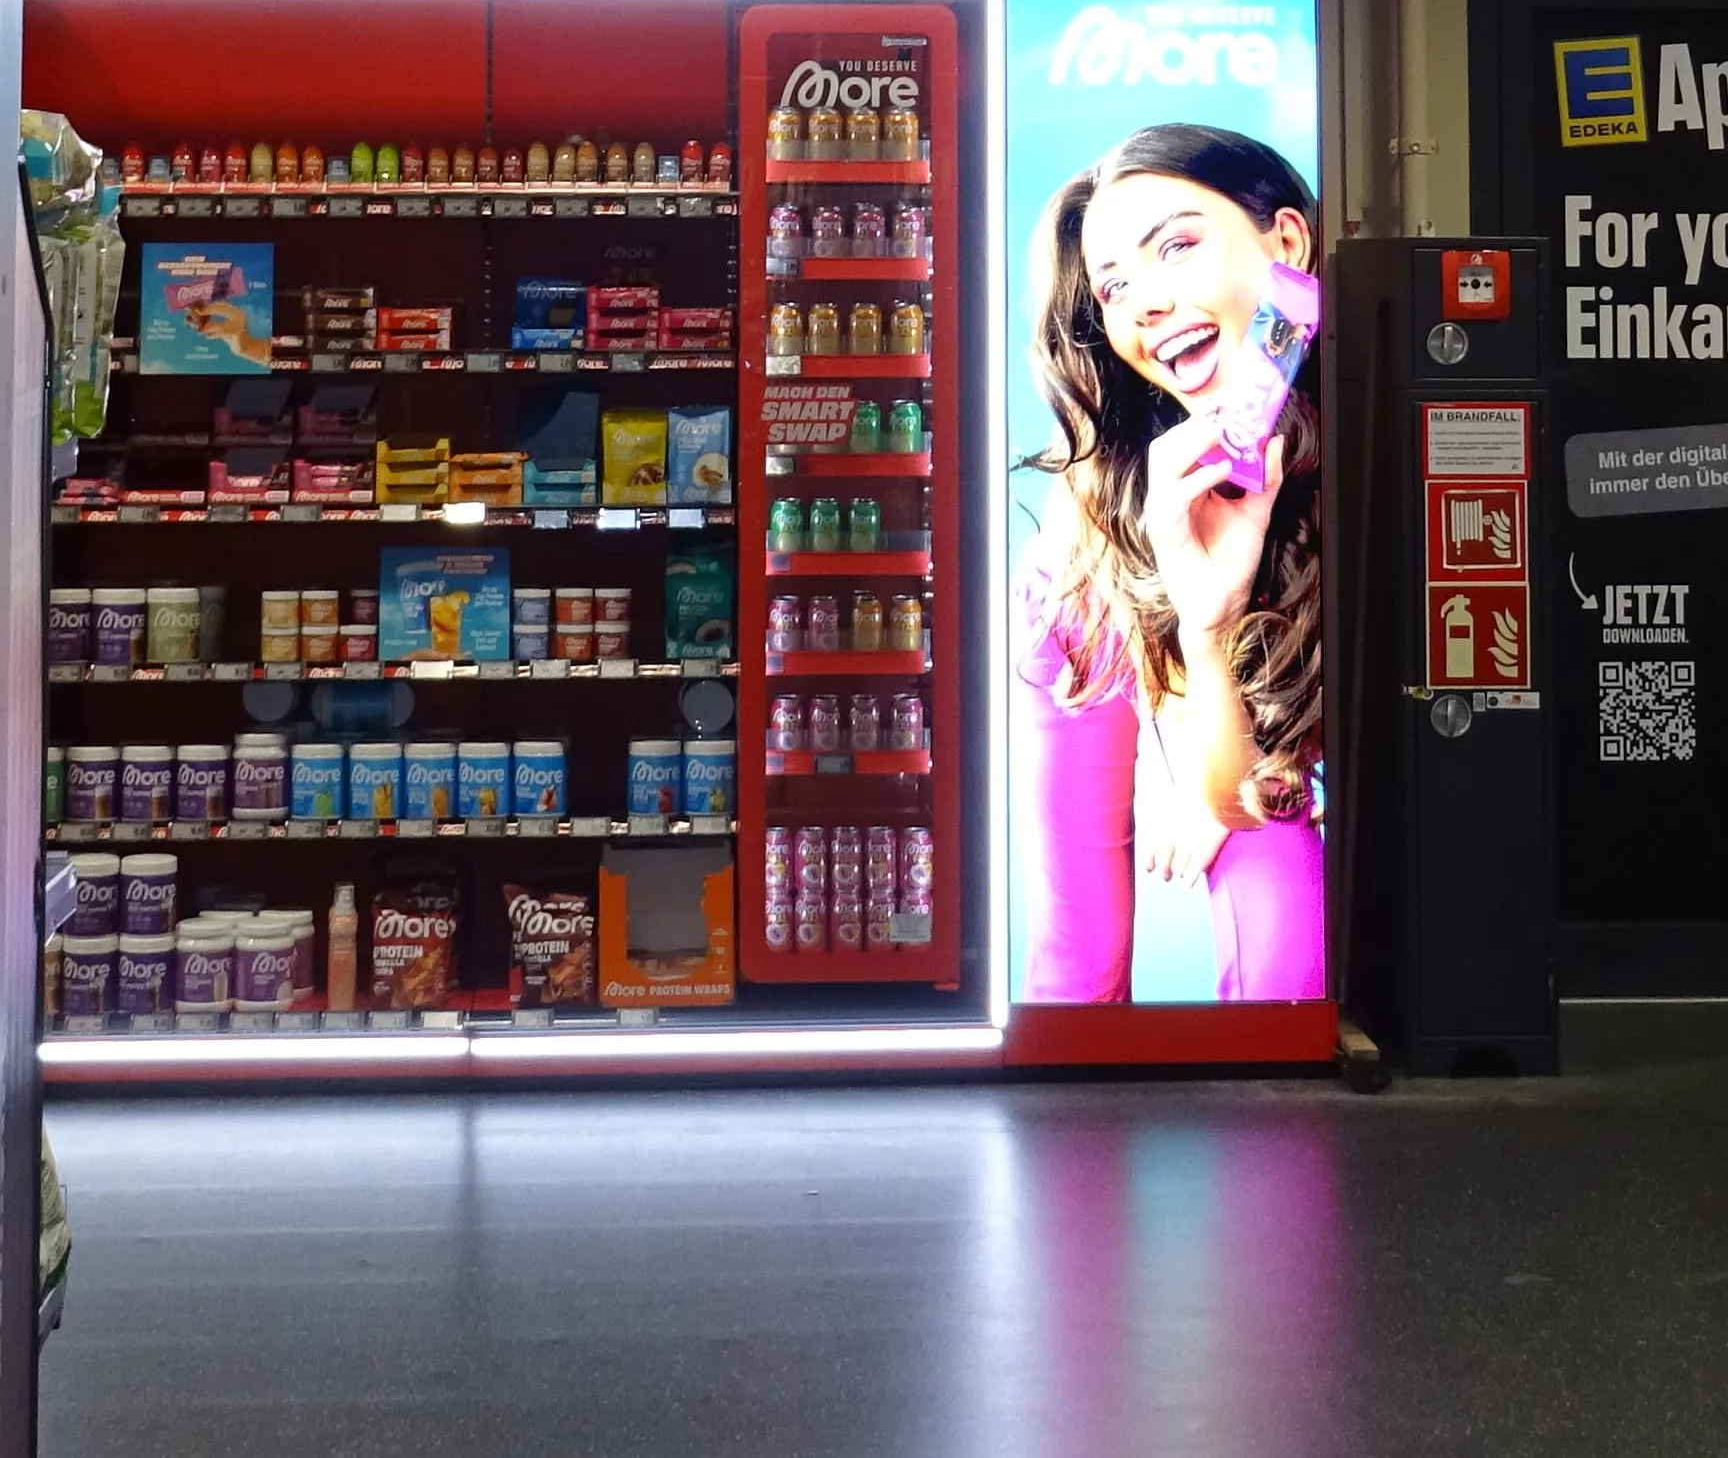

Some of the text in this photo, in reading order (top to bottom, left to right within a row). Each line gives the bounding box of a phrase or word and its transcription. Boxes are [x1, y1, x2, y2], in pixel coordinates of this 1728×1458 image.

[839, 60, 918, 72] YOU DESERVE
[780, 60, 919, 108] More
[1569, 121, 1639, 138] EDEKA
[1564, 195, 1659, 267] For
[764, 386, 850, 399] MACH DEN
[761, 401, 855, 421] SMART
[1430, 411, 1444, 422] IM
[768, 423, 848, 443] SWAP
[1598, 451, 1628, 470] Mit
[1632, 448, 1665, 467] der
[1589, 473, 1650, 496] immer
[1655, 471, 1691, 491] den
[1602, 584, 1690, 626] JETZT
[1602, 628, 1690, 644] DOWNLOADEN.
